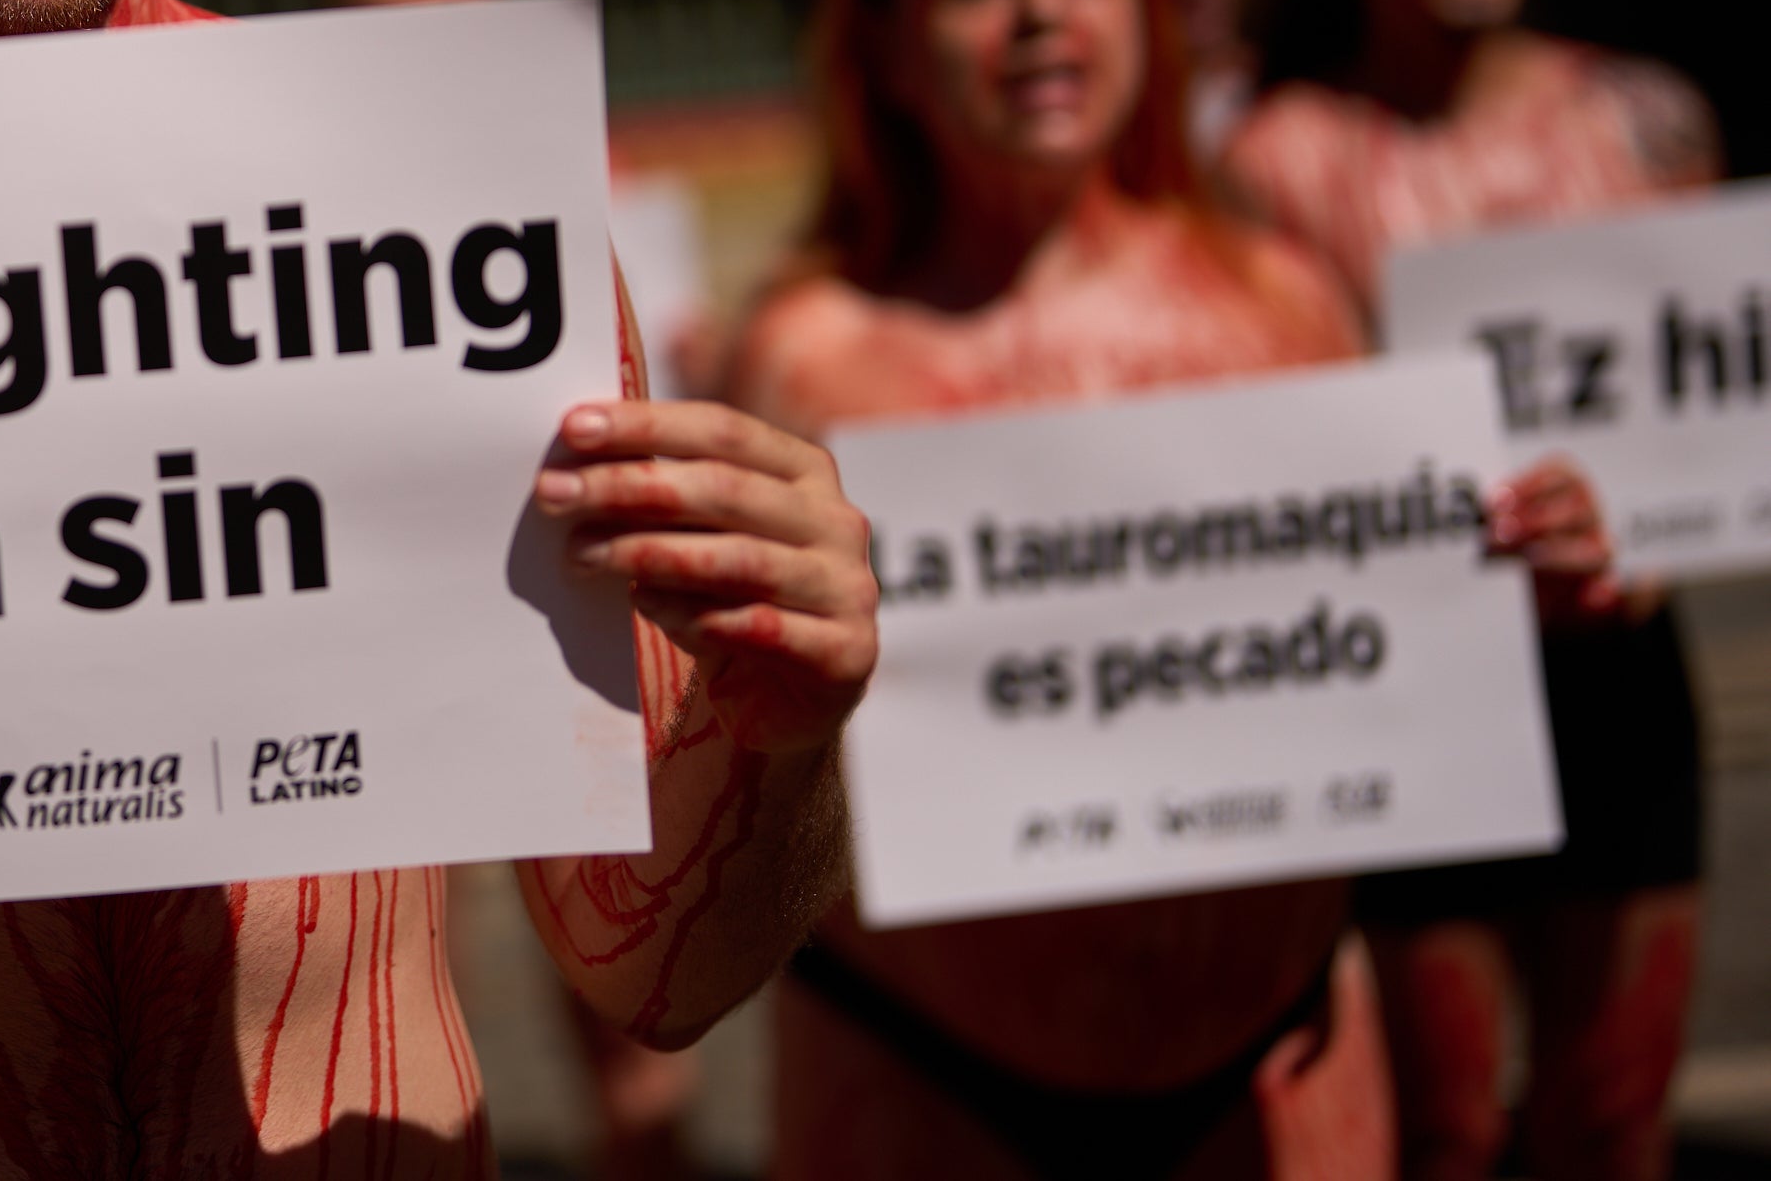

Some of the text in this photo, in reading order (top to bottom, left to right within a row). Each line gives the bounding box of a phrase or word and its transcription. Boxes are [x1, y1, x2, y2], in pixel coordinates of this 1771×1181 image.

[58, 449, 330, 613] sin
[971, 463, 1491, 597] tauromaquia
[982, 599, 1388, 721] es pecado
[25, 784, 185, 830] naturalis
[249, 774, 363, 806] LATINO
